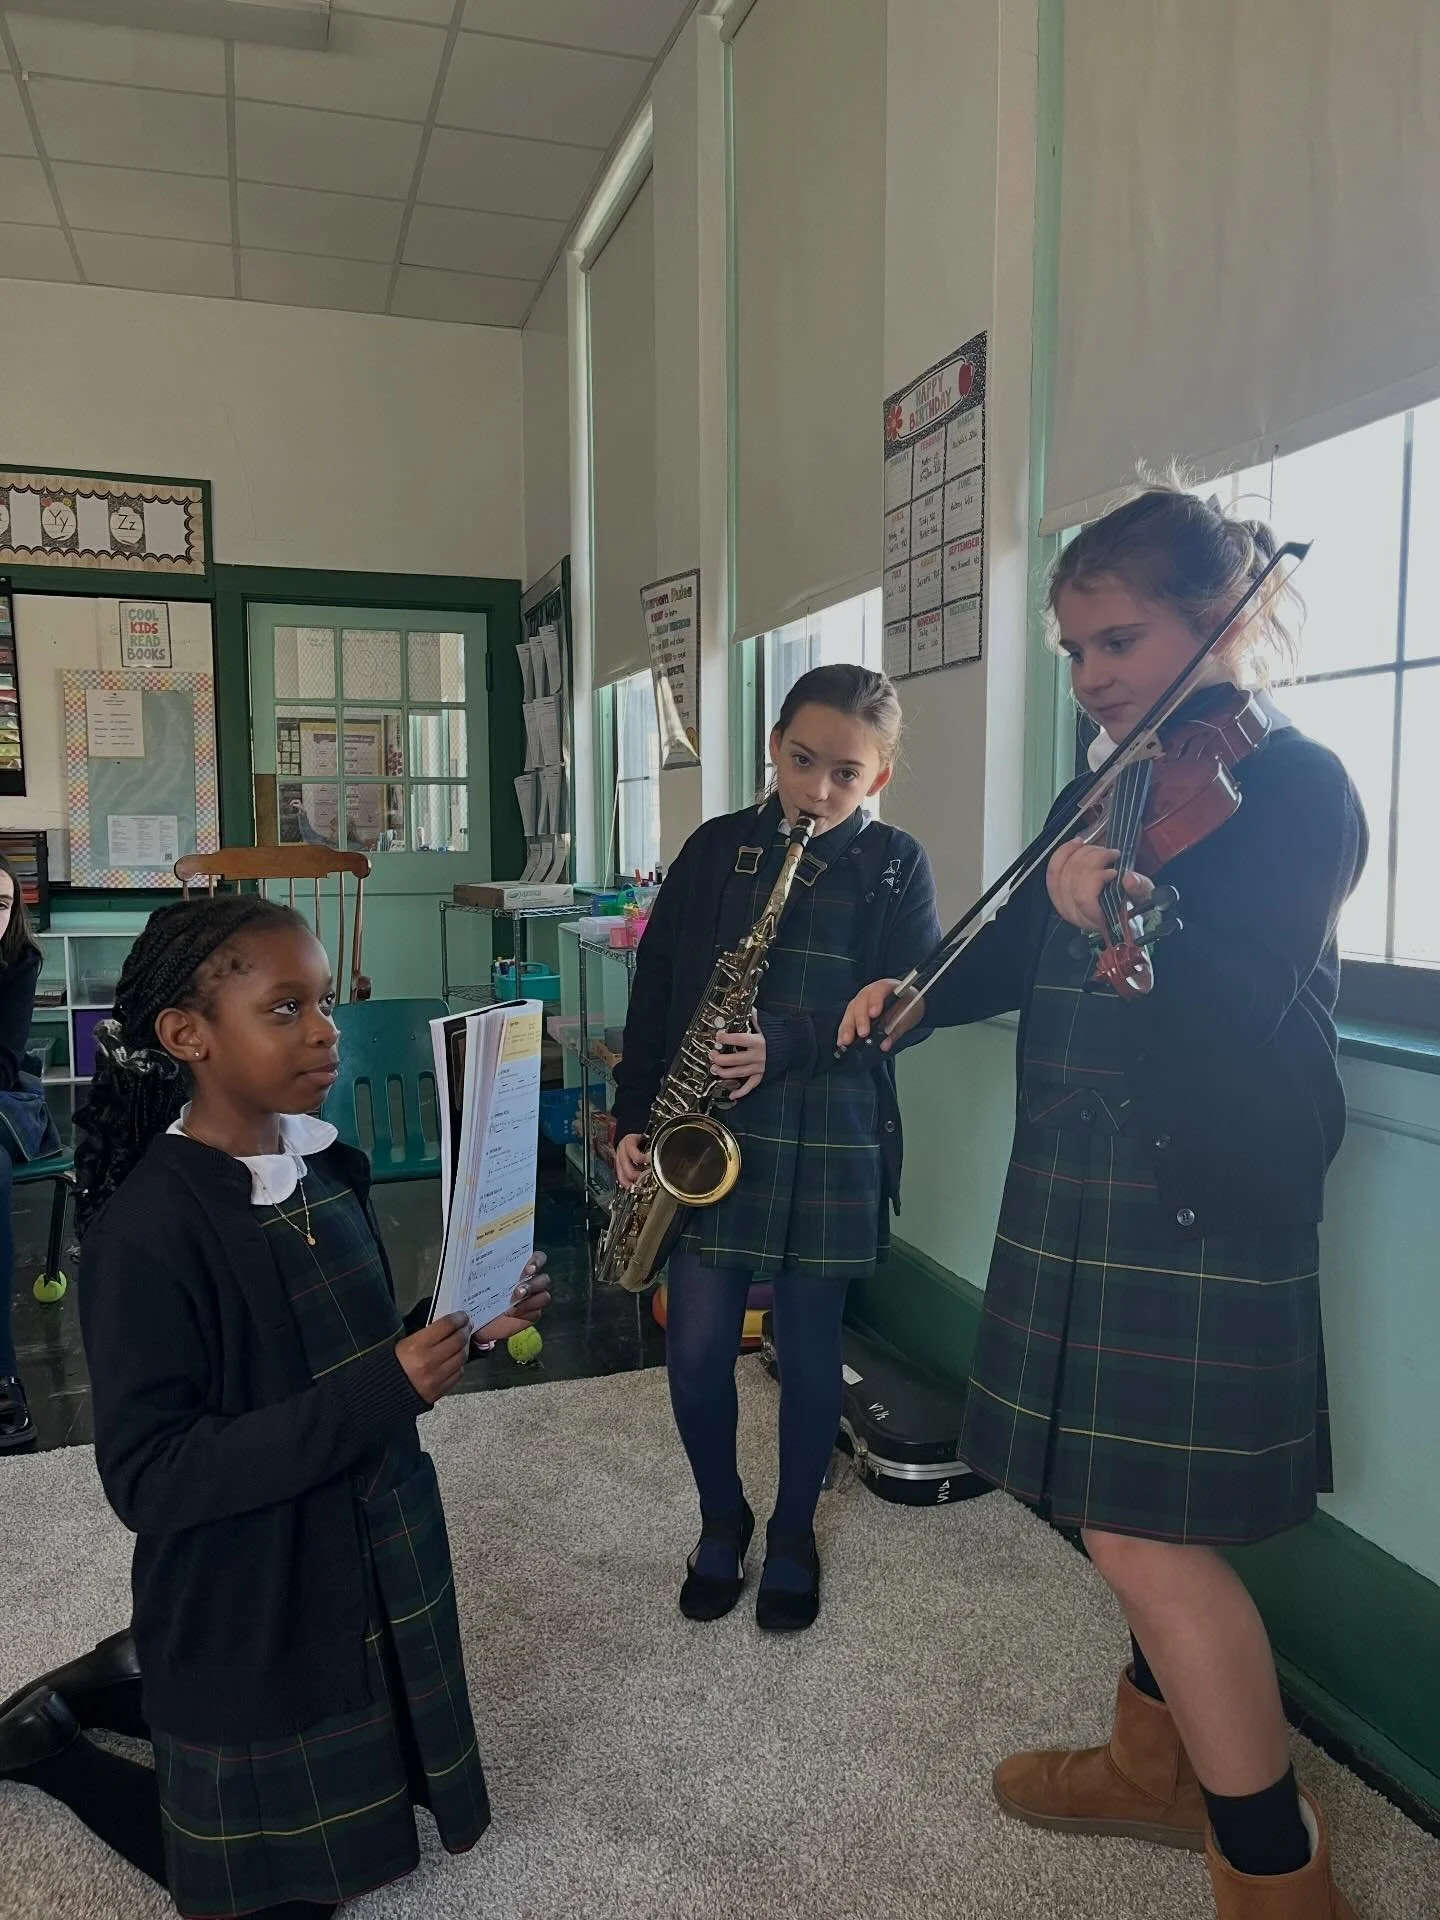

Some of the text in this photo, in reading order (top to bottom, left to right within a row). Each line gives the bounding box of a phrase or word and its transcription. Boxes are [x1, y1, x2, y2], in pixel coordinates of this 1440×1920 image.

[916, 371, 945, 407] HAPPY
[909, 387, 952, 431] BIRTHDAY
[48, 509, 69, 533] Yy
[118, 513, 136, 530] Zz
[948, 536, 980, 557] SEPTEMBER
[127, 608, 160, 621] COOL
[130, 621, 159, 635] KIDS
[130, 635, 161, 648] READ
[127, 647, 166, 660] BOOKS
